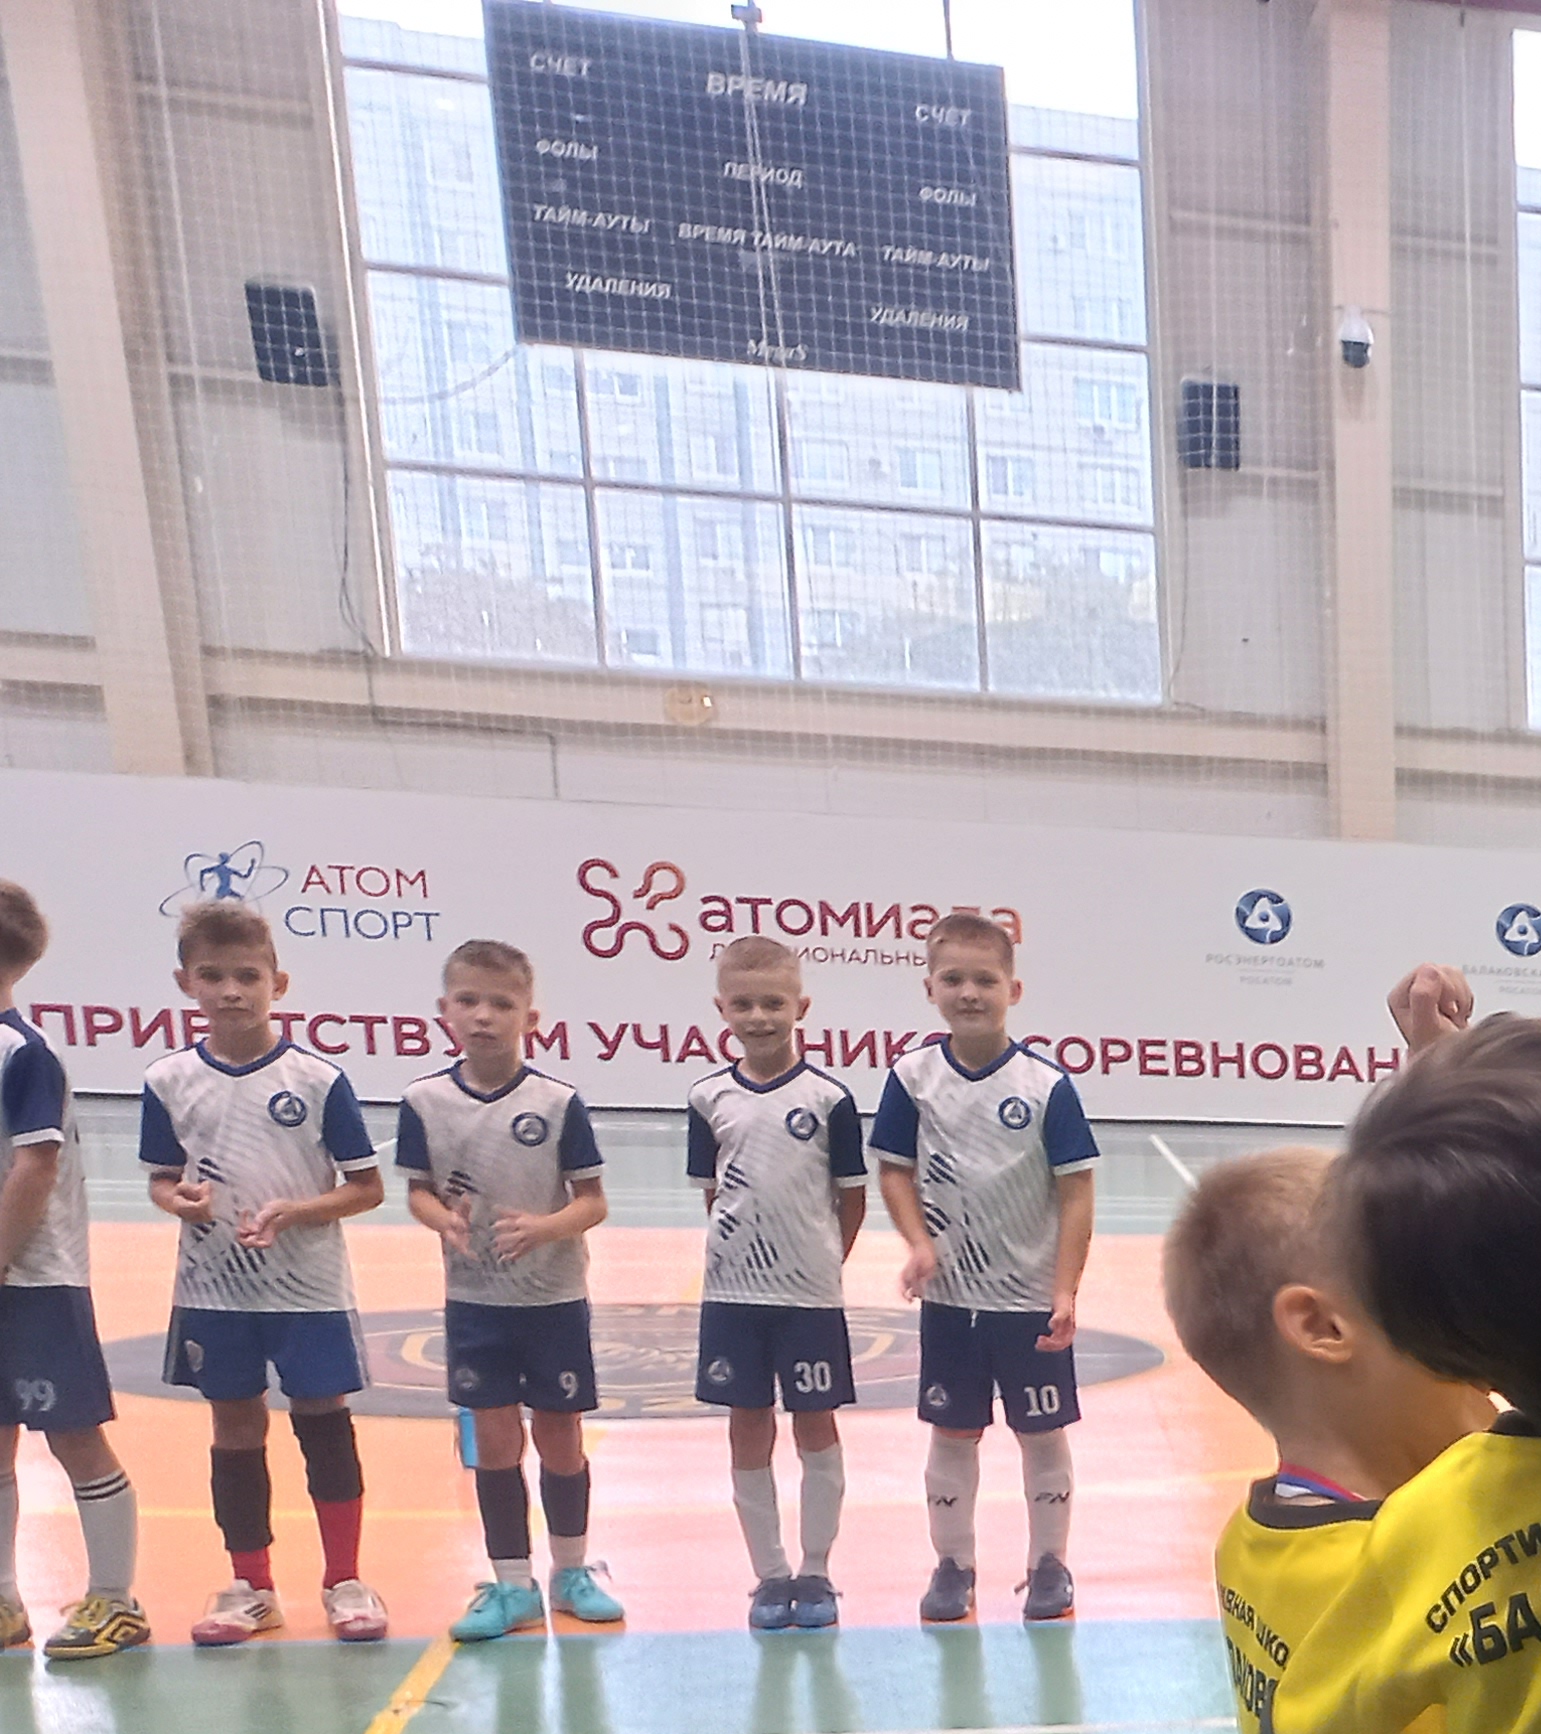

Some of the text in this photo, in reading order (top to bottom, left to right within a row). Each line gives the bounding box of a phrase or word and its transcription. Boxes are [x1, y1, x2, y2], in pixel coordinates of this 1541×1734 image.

[530, 54, 590, 77] СЧЕТ
[706, 72, 808, 106] ВРЕМЯ
[916, 105, 971, 127] СЧЕТ
[536, 139, 598, 161] ФОЛЫ
[724, 162, 803, 189] ПЕРИОД
[919, 186, 977, 208] ФОЛЫ
[680, 223, 745, 246] ВРЕМЯ
[566, 272, 671, 299] УДАЛЕНИЯ
[870, 306, 970, 331] УДАЛЕНИЯ
[300, 864, 430, 899] АТОМ
[284, 906, 440, 942] СПОРТ
[558, 1370, 579, 1399] 9
[794, 1361, 832, 1393] 30
[1024, 1385, 1061, 1417] 10
